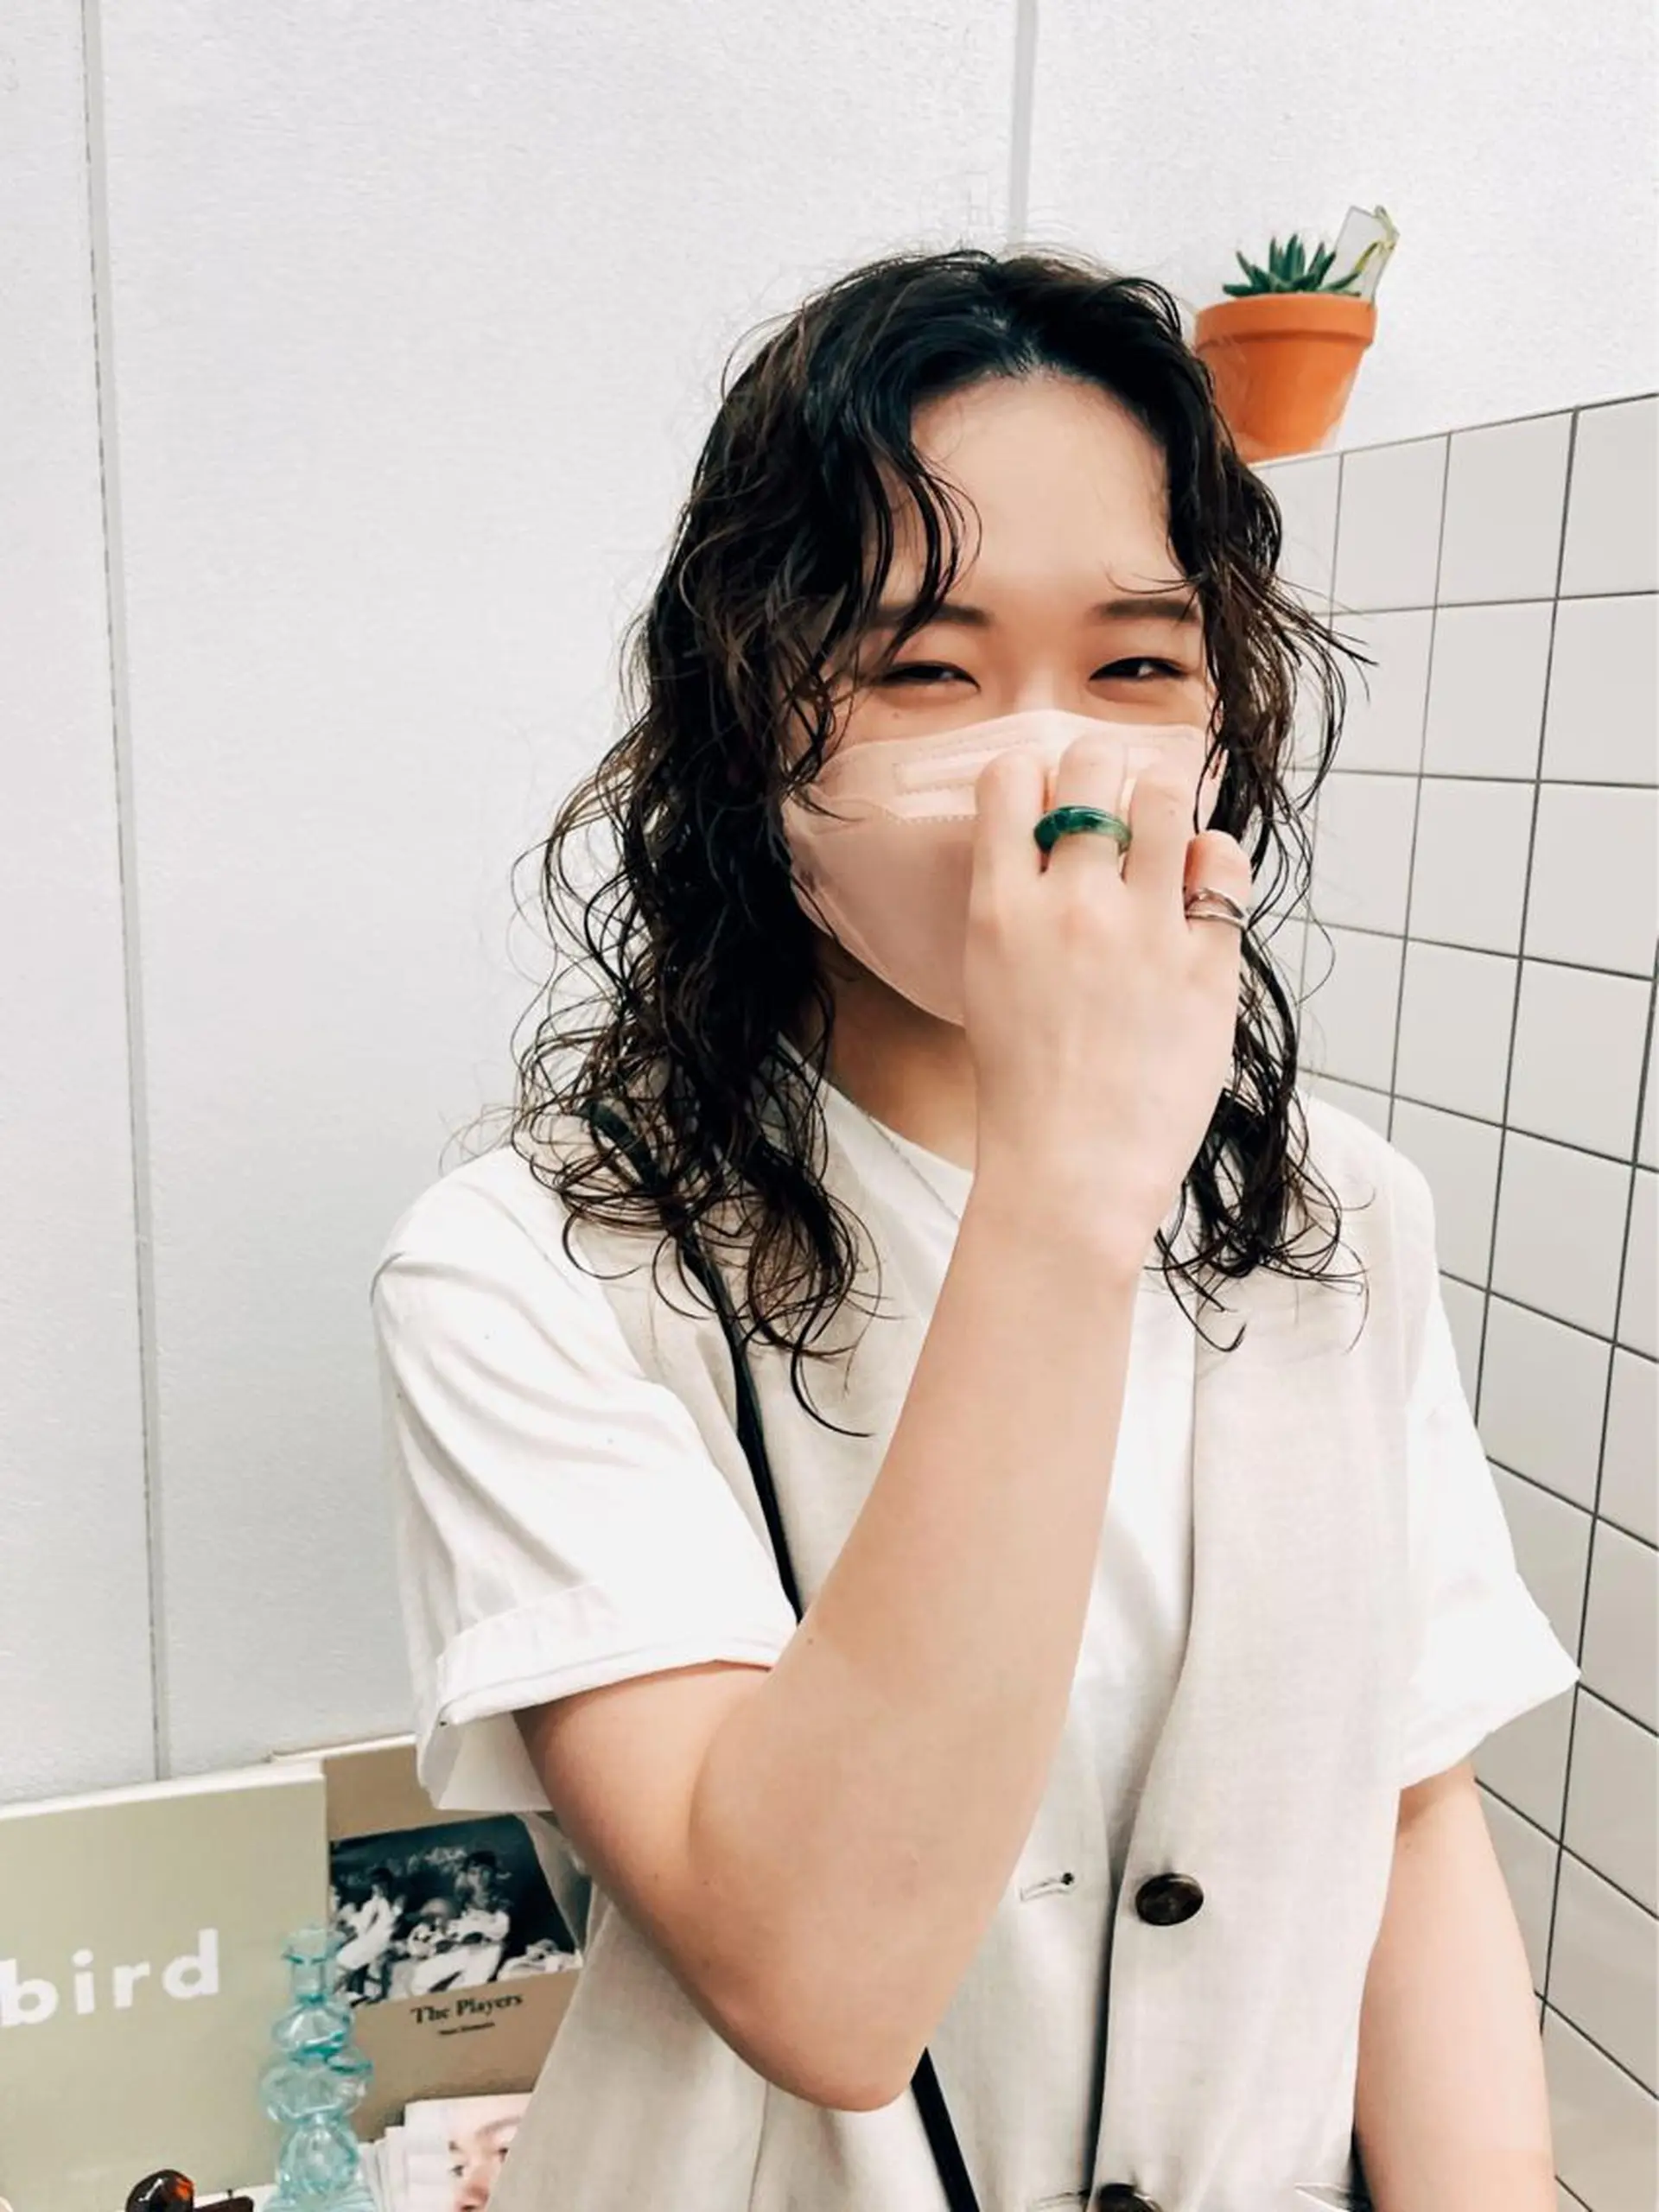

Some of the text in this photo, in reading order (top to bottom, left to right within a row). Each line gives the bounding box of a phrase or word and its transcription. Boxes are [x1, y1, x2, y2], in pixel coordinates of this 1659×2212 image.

[0, 1928, 219, 2027] bird
[410, 1994, 523, 2024] The Players
